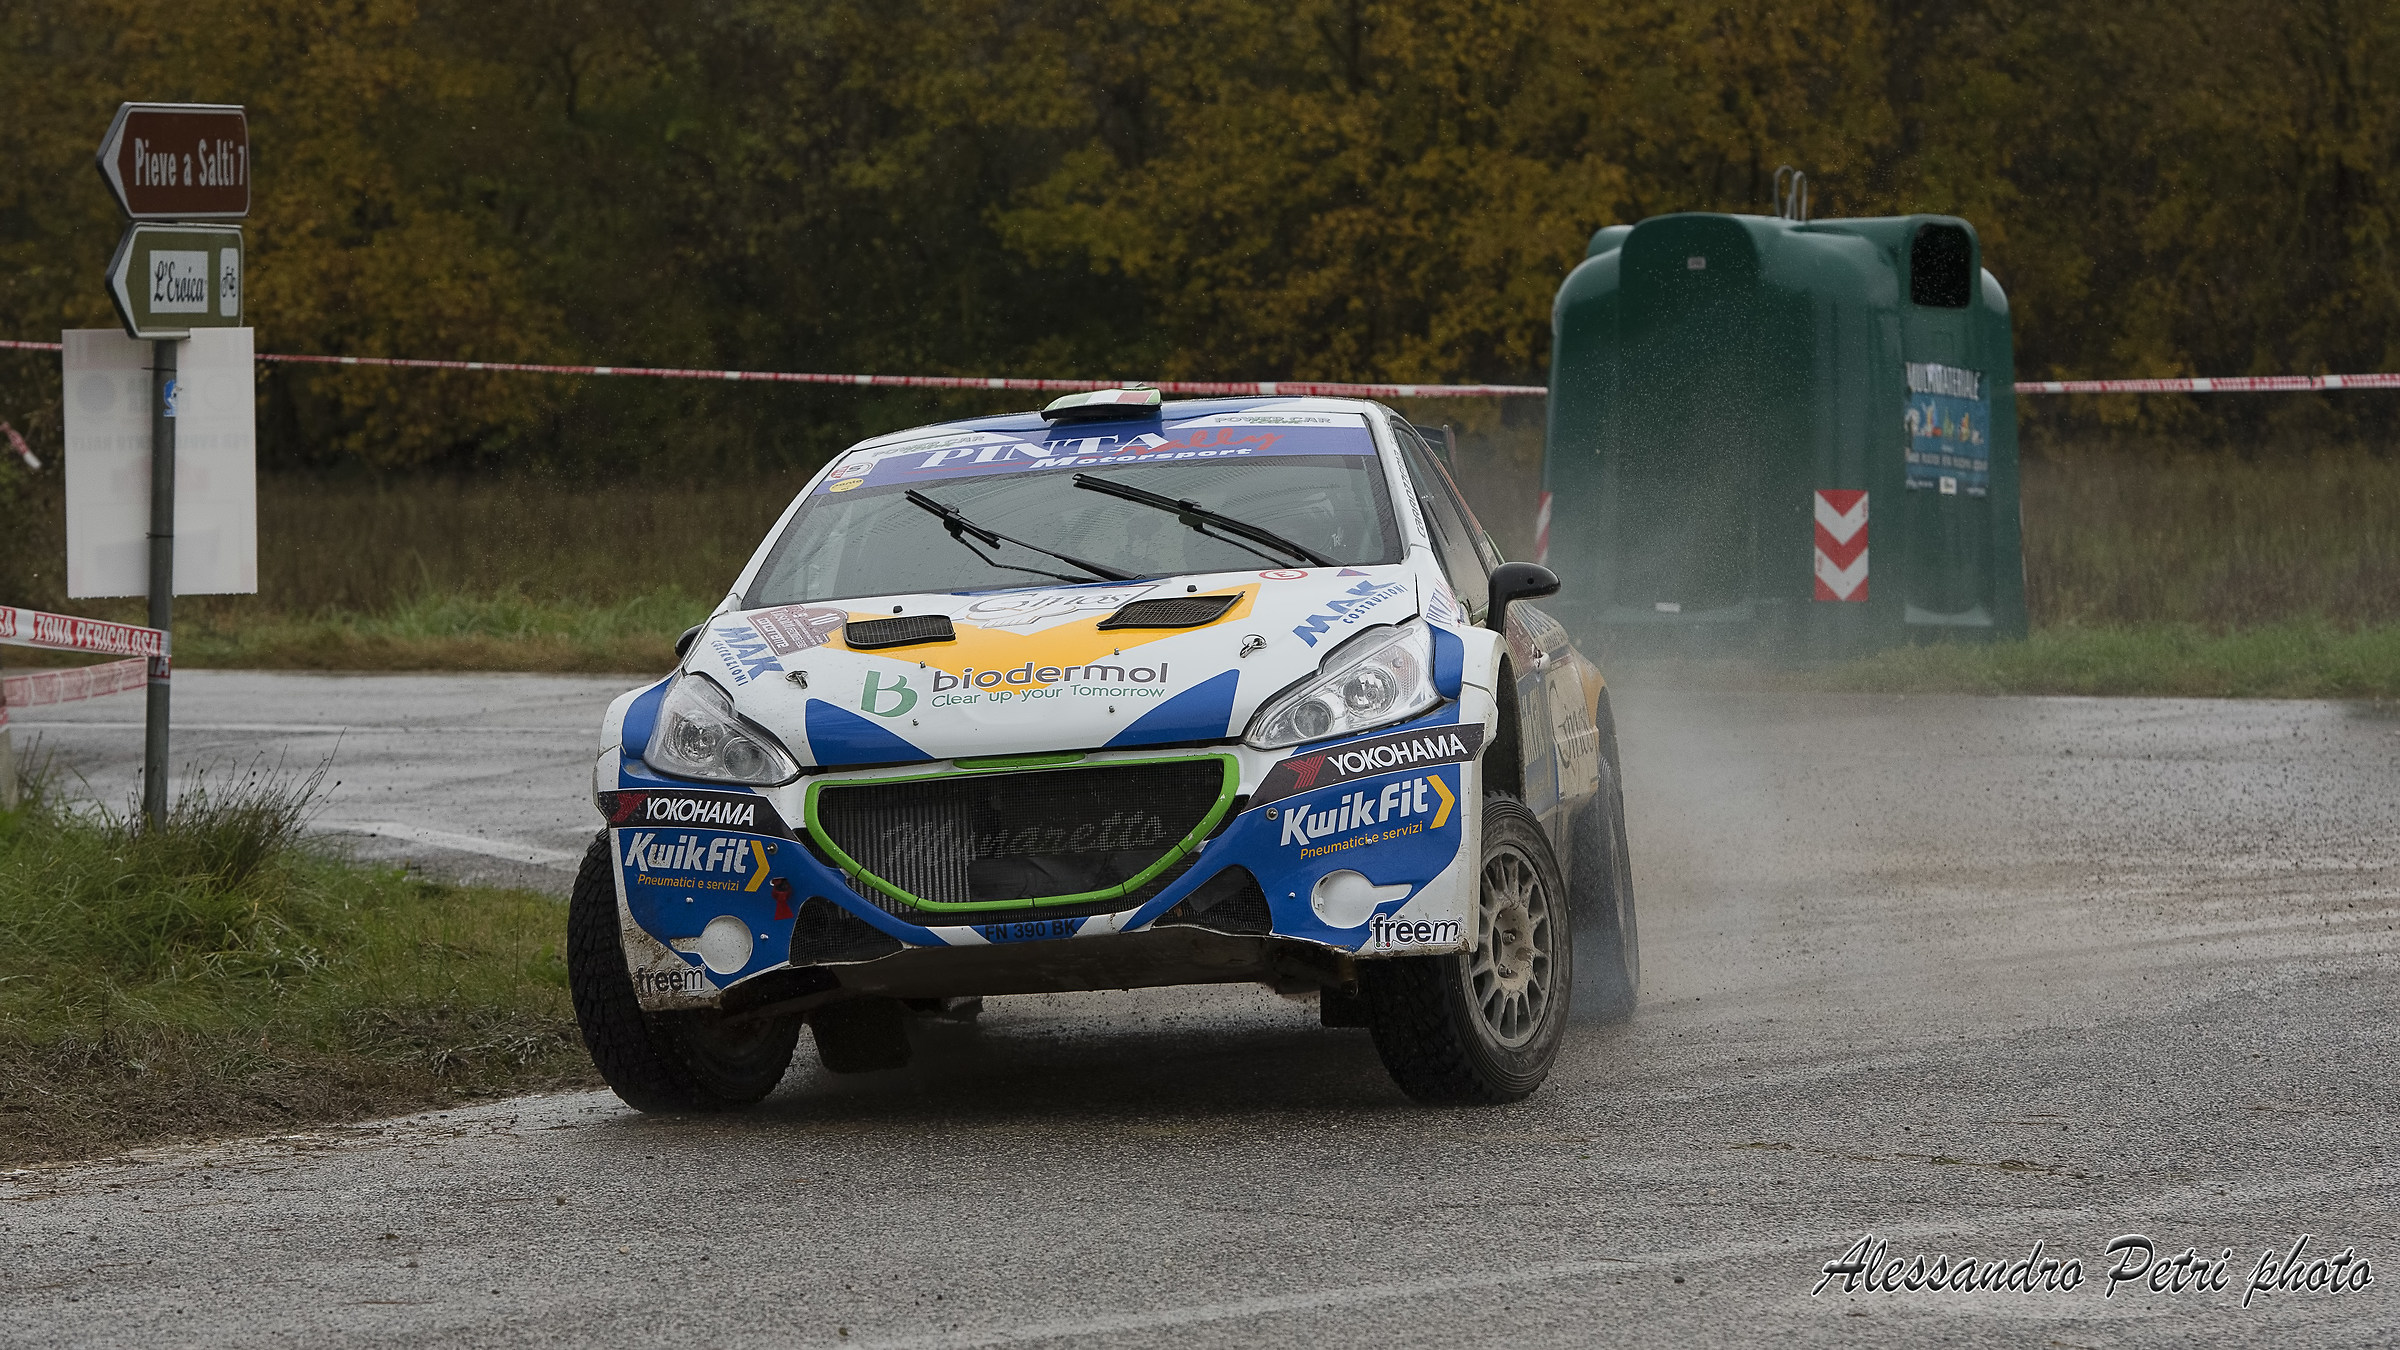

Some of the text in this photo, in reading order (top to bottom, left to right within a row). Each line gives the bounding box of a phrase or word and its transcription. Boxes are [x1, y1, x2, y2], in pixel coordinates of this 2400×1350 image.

[134, 137, 177, 187] Pieve
[183, 152, 192, 187] a
[198, 138, 234, 187] Salti
[153, 260, 205, 303] L'Eroica
[915, 431, 1174, 470] PINTA
[1028, 447, 1253, 469] Motorsport
[1292, 580, 1396, 648] MAK
[1343, 584, 1408, 625] COSTRUZIONI
[36, 614, 74, 645] ZONA
[76, 621, 159, 655] PERICOLOSA
[713, 626, 784, 680] MAK
[710, 640, 749, 687] COSTRUZIONI
[932, 662, 1169, 693] biodermol
[931, 683, 1166, 708] Clear up your Tomorrow
[1327, 733, 1468, 777] YOKOHAMA
[645, 797, 755, 827] YOKOHAMA
[1300, 820, 1423, 860] Pneumatici e servizi
[637, 873, 740, 892] Pneumatici e servizi
[985, 919, 1078, 941] FN 390 BK
[1371, 914, 1458, 944] freem
[637, 965, 706, 993] freem
